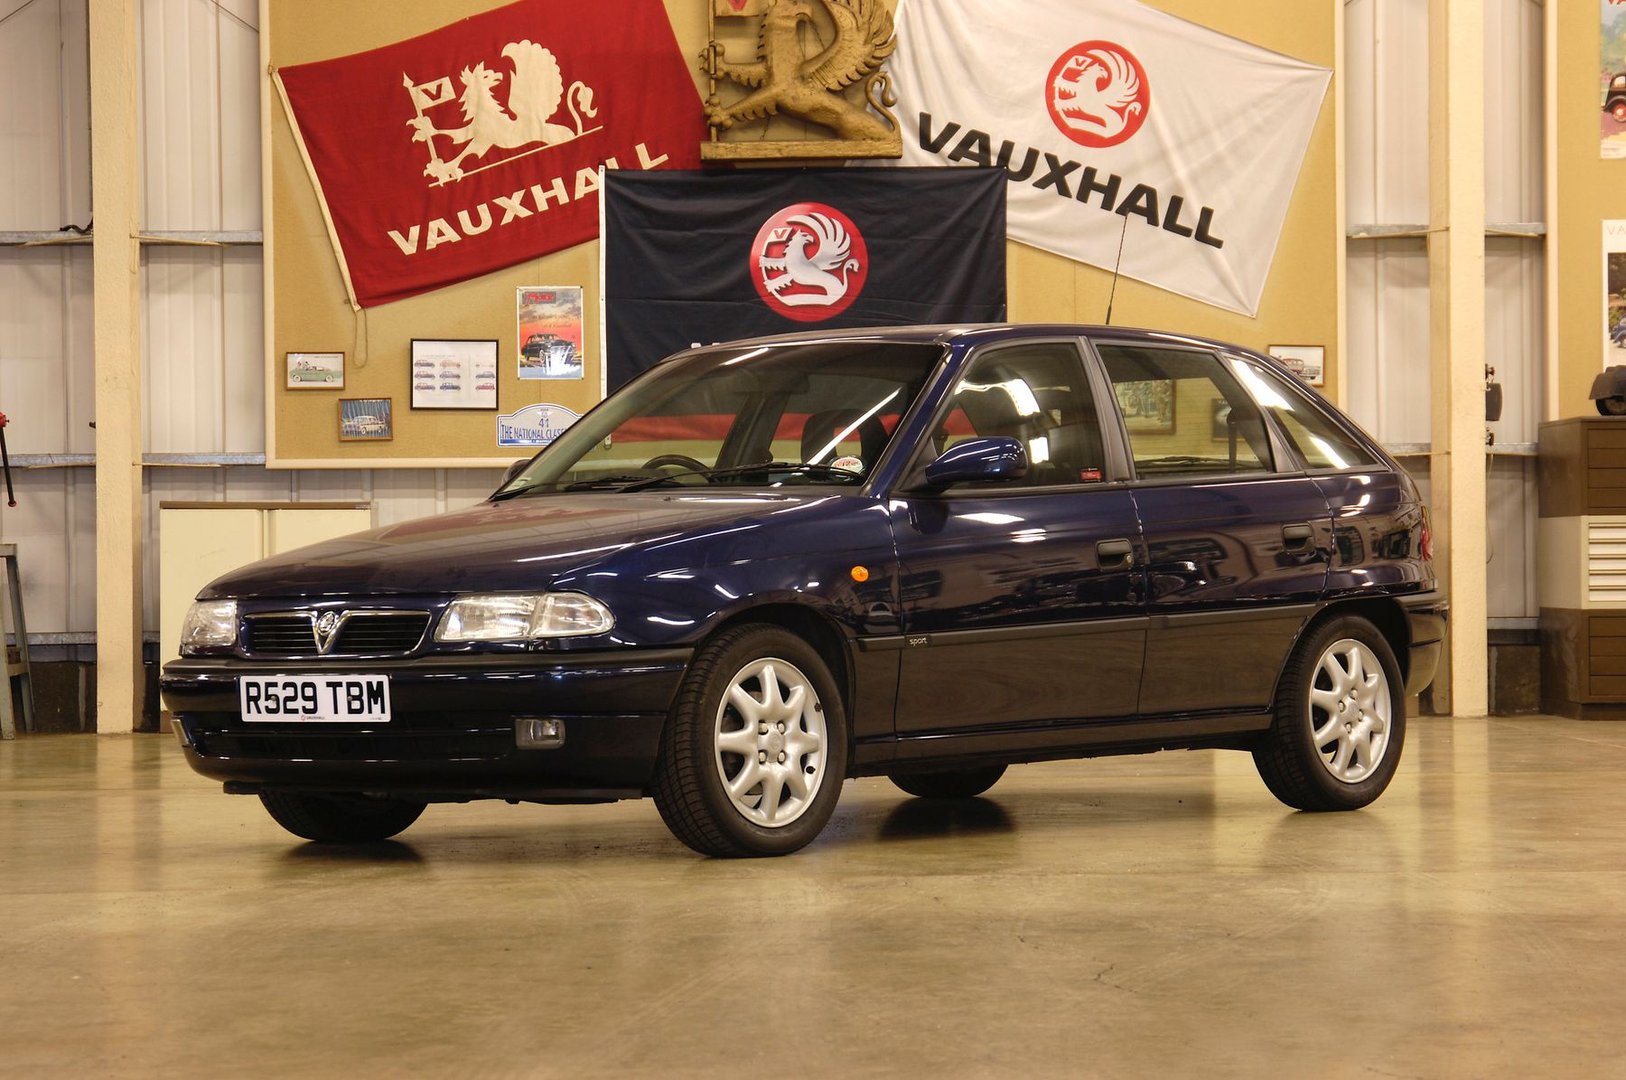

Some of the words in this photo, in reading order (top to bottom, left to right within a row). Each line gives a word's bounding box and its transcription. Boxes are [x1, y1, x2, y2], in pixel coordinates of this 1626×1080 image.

[421, 83, 443, 101] V
[919, 111, 1224, 249] VAUXHALL
[500, 424, 513, 439] THE
[514, 426, 544, 439] NATIONAL
[538, 418, 549, 428] 41
[245, 681, 319, 714] R529
[325, 680, 386, 715] TBM
